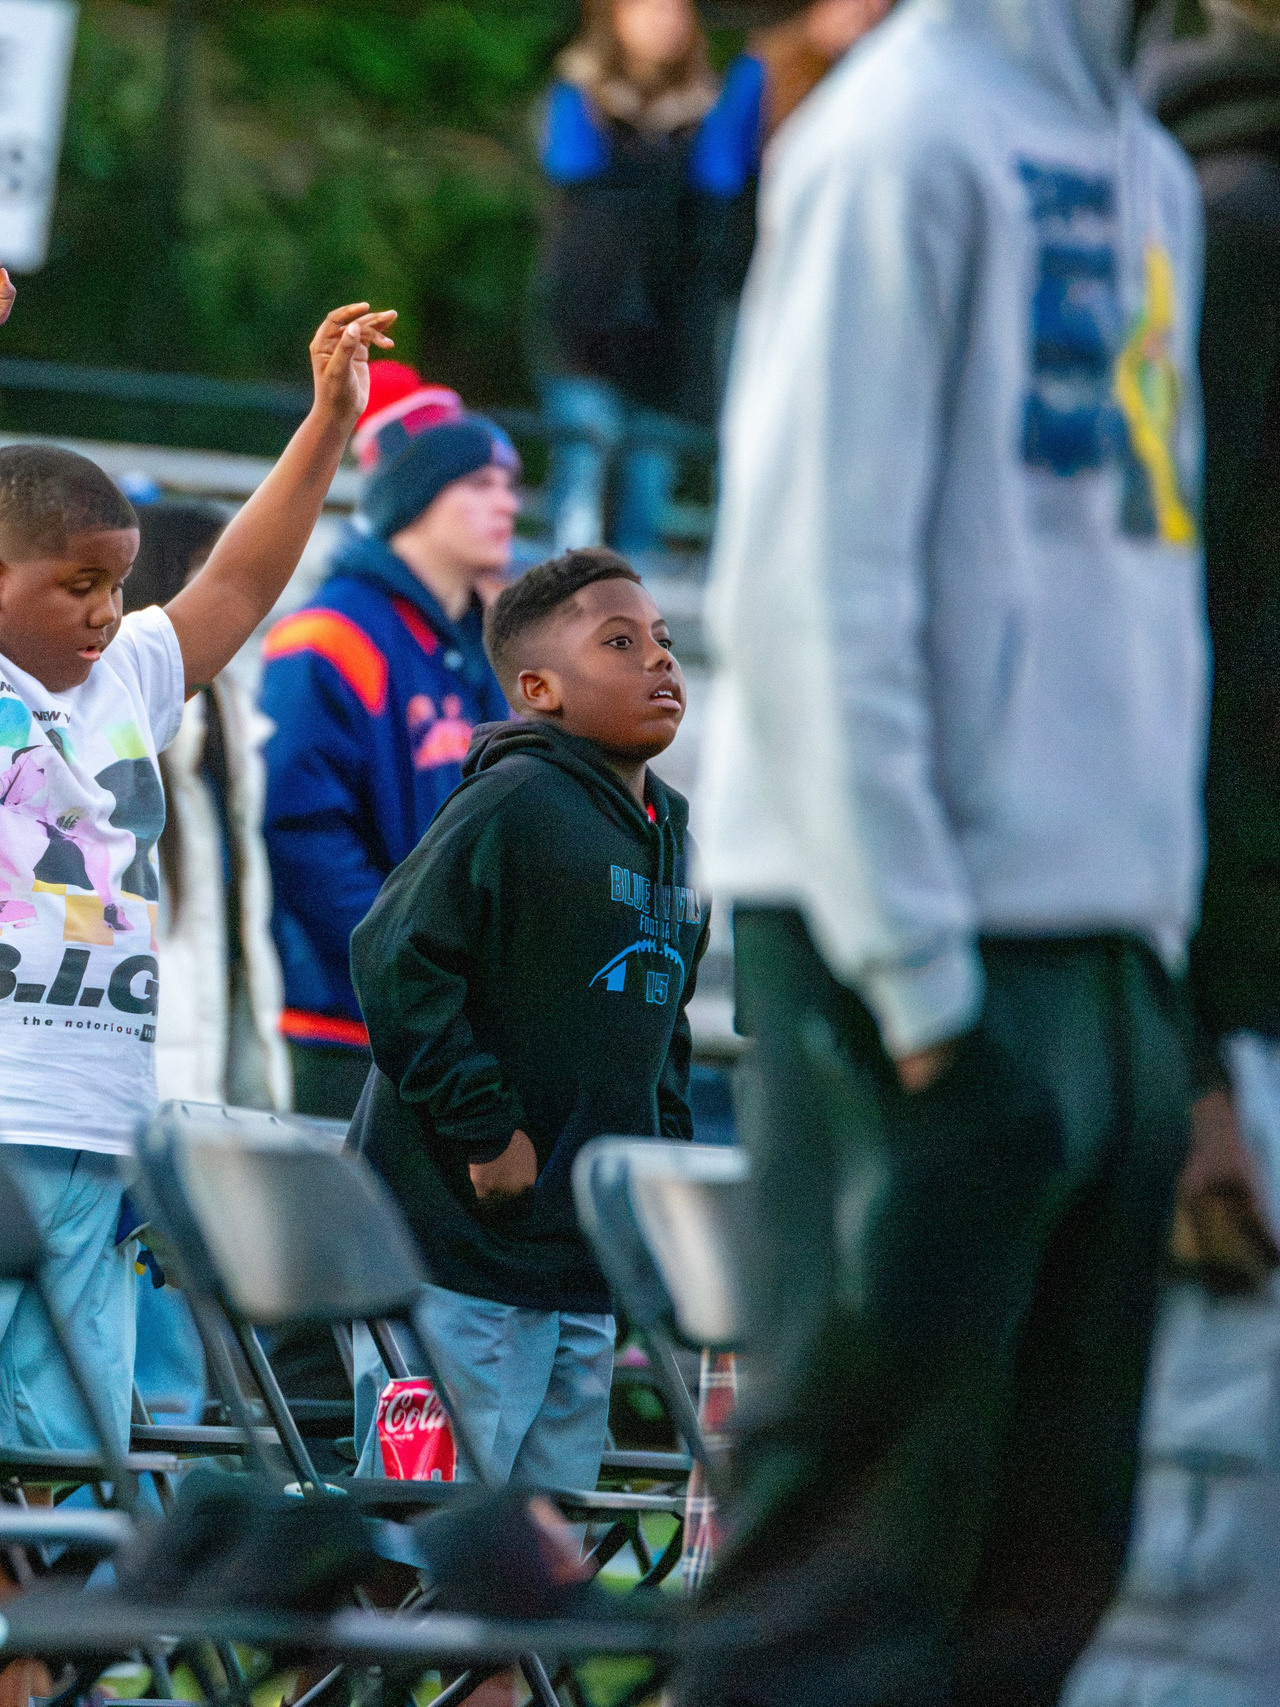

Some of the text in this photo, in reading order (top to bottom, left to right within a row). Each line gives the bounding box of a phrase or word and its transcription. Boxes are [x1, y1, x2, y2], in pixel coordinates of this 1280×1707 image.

[32, 710, 61, 722] NEW
[610, 864, 651, 914] BLUE
[645, 971, 669, 1005] 15
[23, 1016, 53, 1026] the
[65, 1018, 140, 1036] notorious
